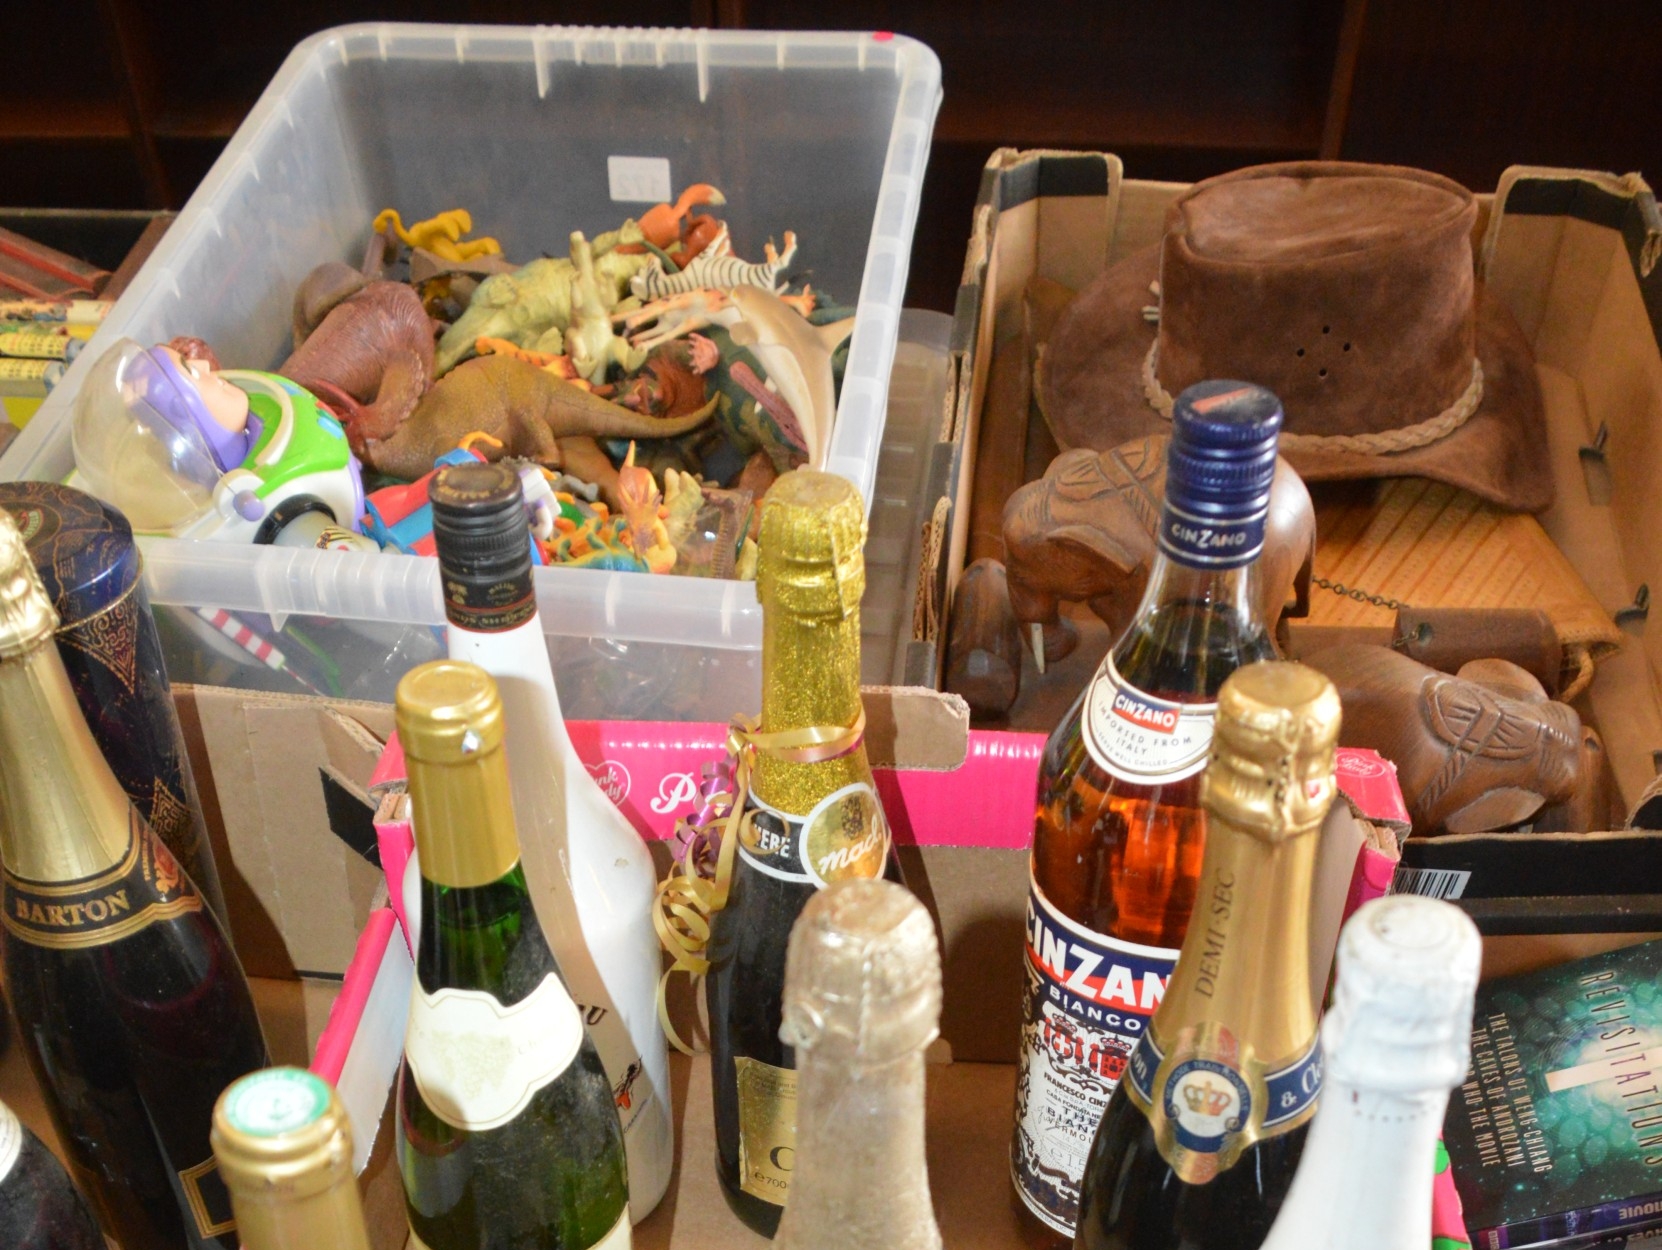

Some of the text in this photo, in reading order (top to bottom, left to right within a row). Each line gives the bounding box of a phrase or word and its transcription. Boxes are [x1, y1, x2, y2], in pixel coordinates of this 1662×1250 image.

[1171, 523, 1246, 548] CINZANO
[1099, 701, 1191, 746] IMPORTED FROM
[1115, 695, 1175, 727] CINZANO
[1116, 737, 1146, 754] ITALY
[15, 889, 130, 926] BARTON
[1026, 896, 1171, 1009] CINZAN
[1050, 985, 1141, 1031] BIANCO
[1488, 1012, 1510, 1033] THE
[1495, 1035, 1522, 1076] TALONS
[1580, 970, 1662, 1166] REVISITATIONS
[1044, 1072, 1086, 1100] FRANCESCO
[1462, 1080, 1484, 1105] WHO
[1471, 1028, 1527, 1167] THE CAVES OF ANDROZANI
[1507, 1077, 1528, 1091] OF
[1063, 1106, 1098, 1127] THE
[1469, 1108, 1490, 1130] THE
[1475, 1132, 1501, 1168] MOVIE
